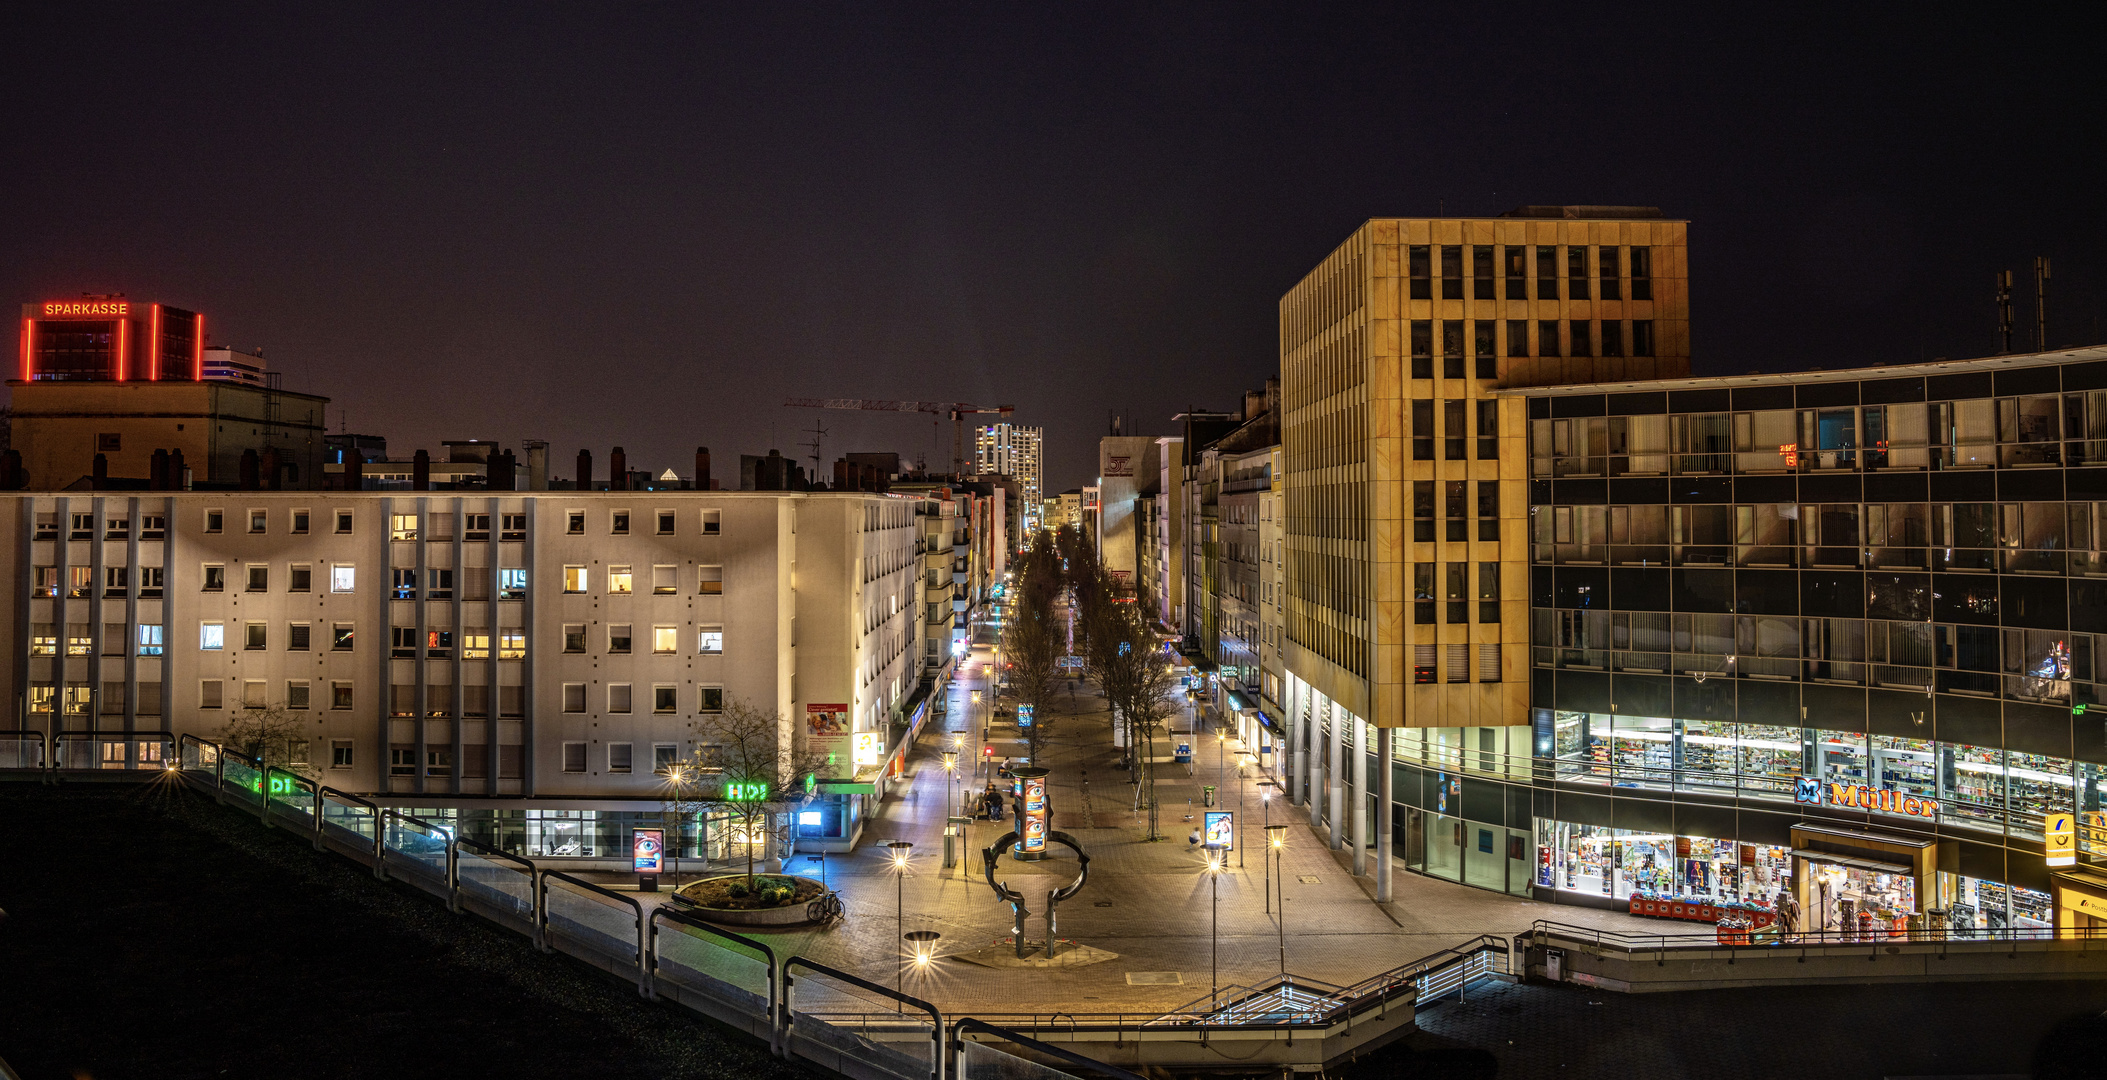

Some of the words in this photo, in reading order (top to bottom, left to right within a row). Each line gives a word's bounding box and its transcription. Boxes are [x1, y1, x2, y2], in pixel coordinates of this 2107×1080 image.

[45, 303, 127, 315] SPARKASSE
[727, 783, 767, 800] HDI
[1801, 784, 1815, 797] M
[1830, 782, 1939, 818] Müller
